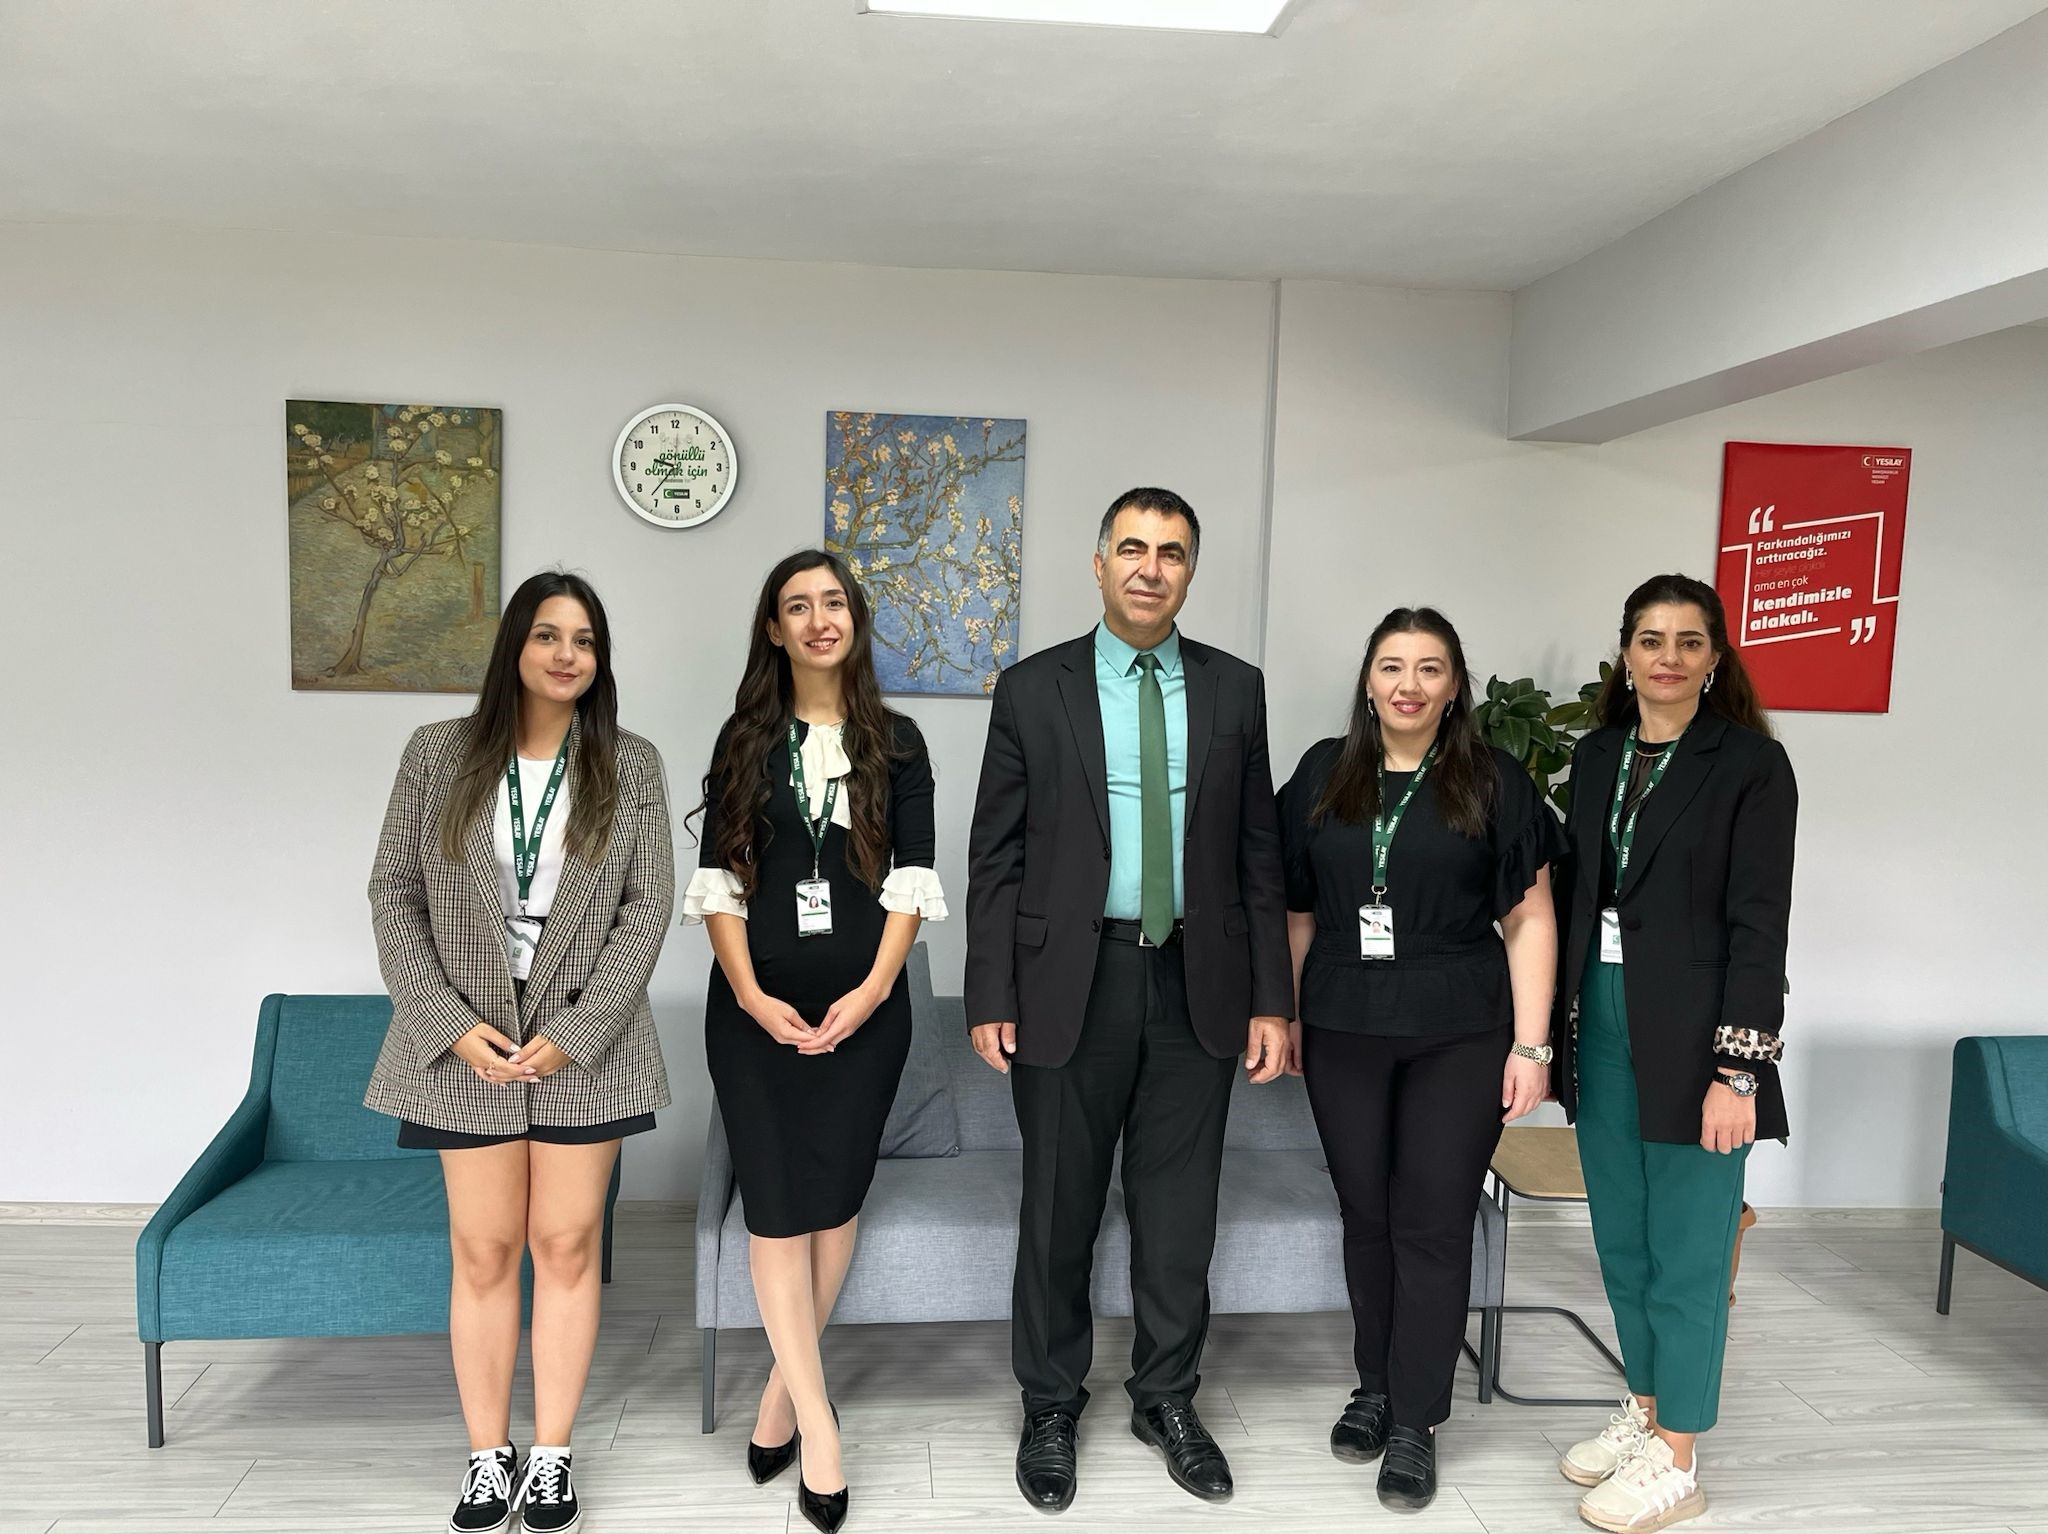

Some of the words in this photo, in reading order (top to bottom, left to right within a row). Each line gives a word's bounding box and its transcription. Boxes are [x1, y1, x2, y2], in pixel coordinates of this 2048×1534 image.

[670, 420, 680, 428] 12
[650, 425, 658, 434] 11
[695, 426, 698, 434] 1
[634, 440, 644, 449] 10
[710, 441, 716, 450] 2
[660, 446, 706, 467] gönüllü
[630, 462, 636, 471] 9
[645, 462, 683, 476] olmak
[688, 465, 708, 480] için
[717, 463, 722, 471] 3
[637, 483, 642, 492] 8
[711, 484, 717, 493] 4
[654, 499, 658, 508] 7
[696, 499, 701, 508] 5
[674, 505, 679, 513] 6
[1757, 530, 1851, 552] Farkındalığımızı
[1756, 547, 1828, 565] arttıracağız.
[1754, 581, 1775, 592] ama
[1777, 579, 1790, 588] en
[1792, 575, 1809, 589] çok
[1753, 586, 1852, 612] kendimizle
[1750, 610, 1818, 631] alakalı.
